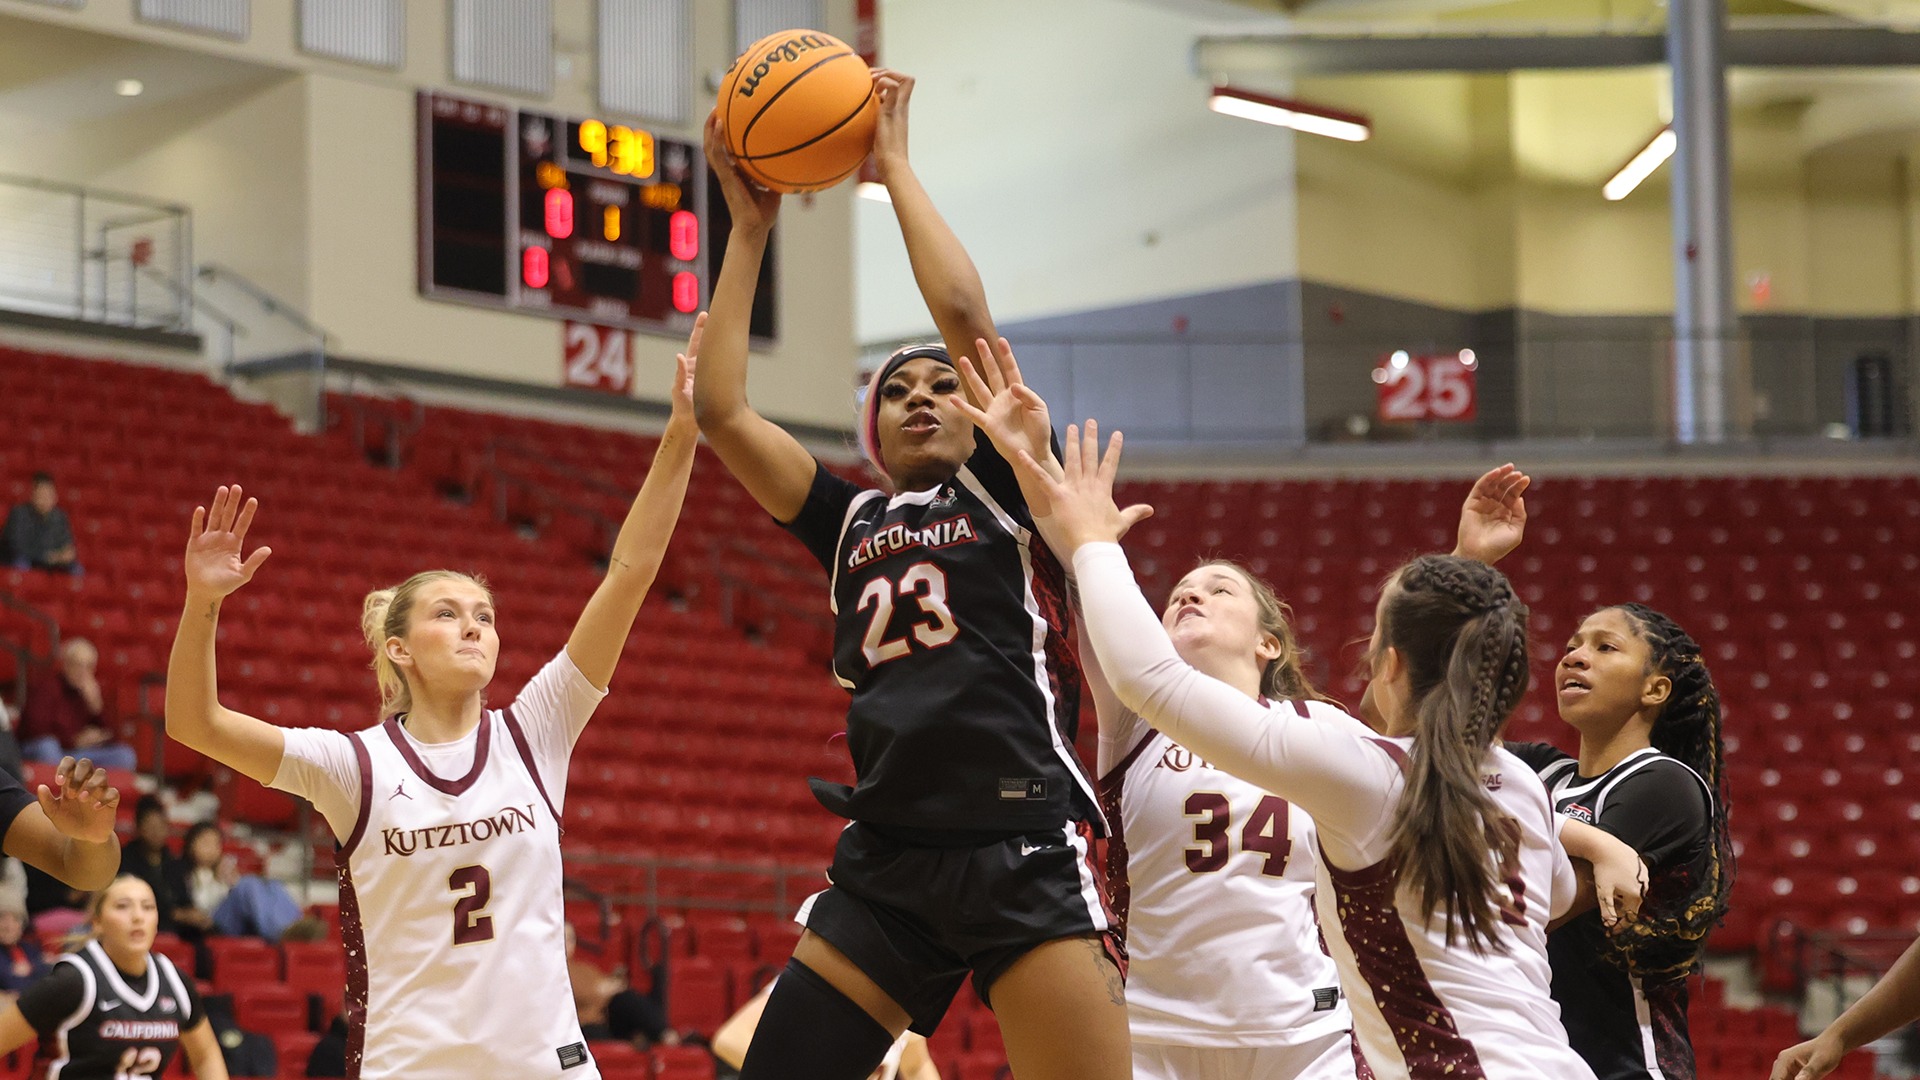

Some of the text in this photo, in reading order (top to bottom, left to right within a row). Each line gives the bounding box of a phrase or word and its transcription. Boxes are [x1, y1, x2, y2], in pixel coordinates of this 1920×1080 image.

[739, 34, 836, 97] Wilson
[545, 188, 573, 239] 0
[604, 205, 620, 241] 1
[670, 211, 698, 261] 0
[566, 324, 629, 389] 24
[1382, 357, 1472, 418] 25
[856, 561, 961, 668] 23
[1032, 784, 1042, 794] M
[381, 804, 536, 857] KUTZTOWN
[1183, 790, 1294, 880] 34
[449, 864, 495, 946] 2
[101, 1020, 180, 1040] CALIFORNIA
